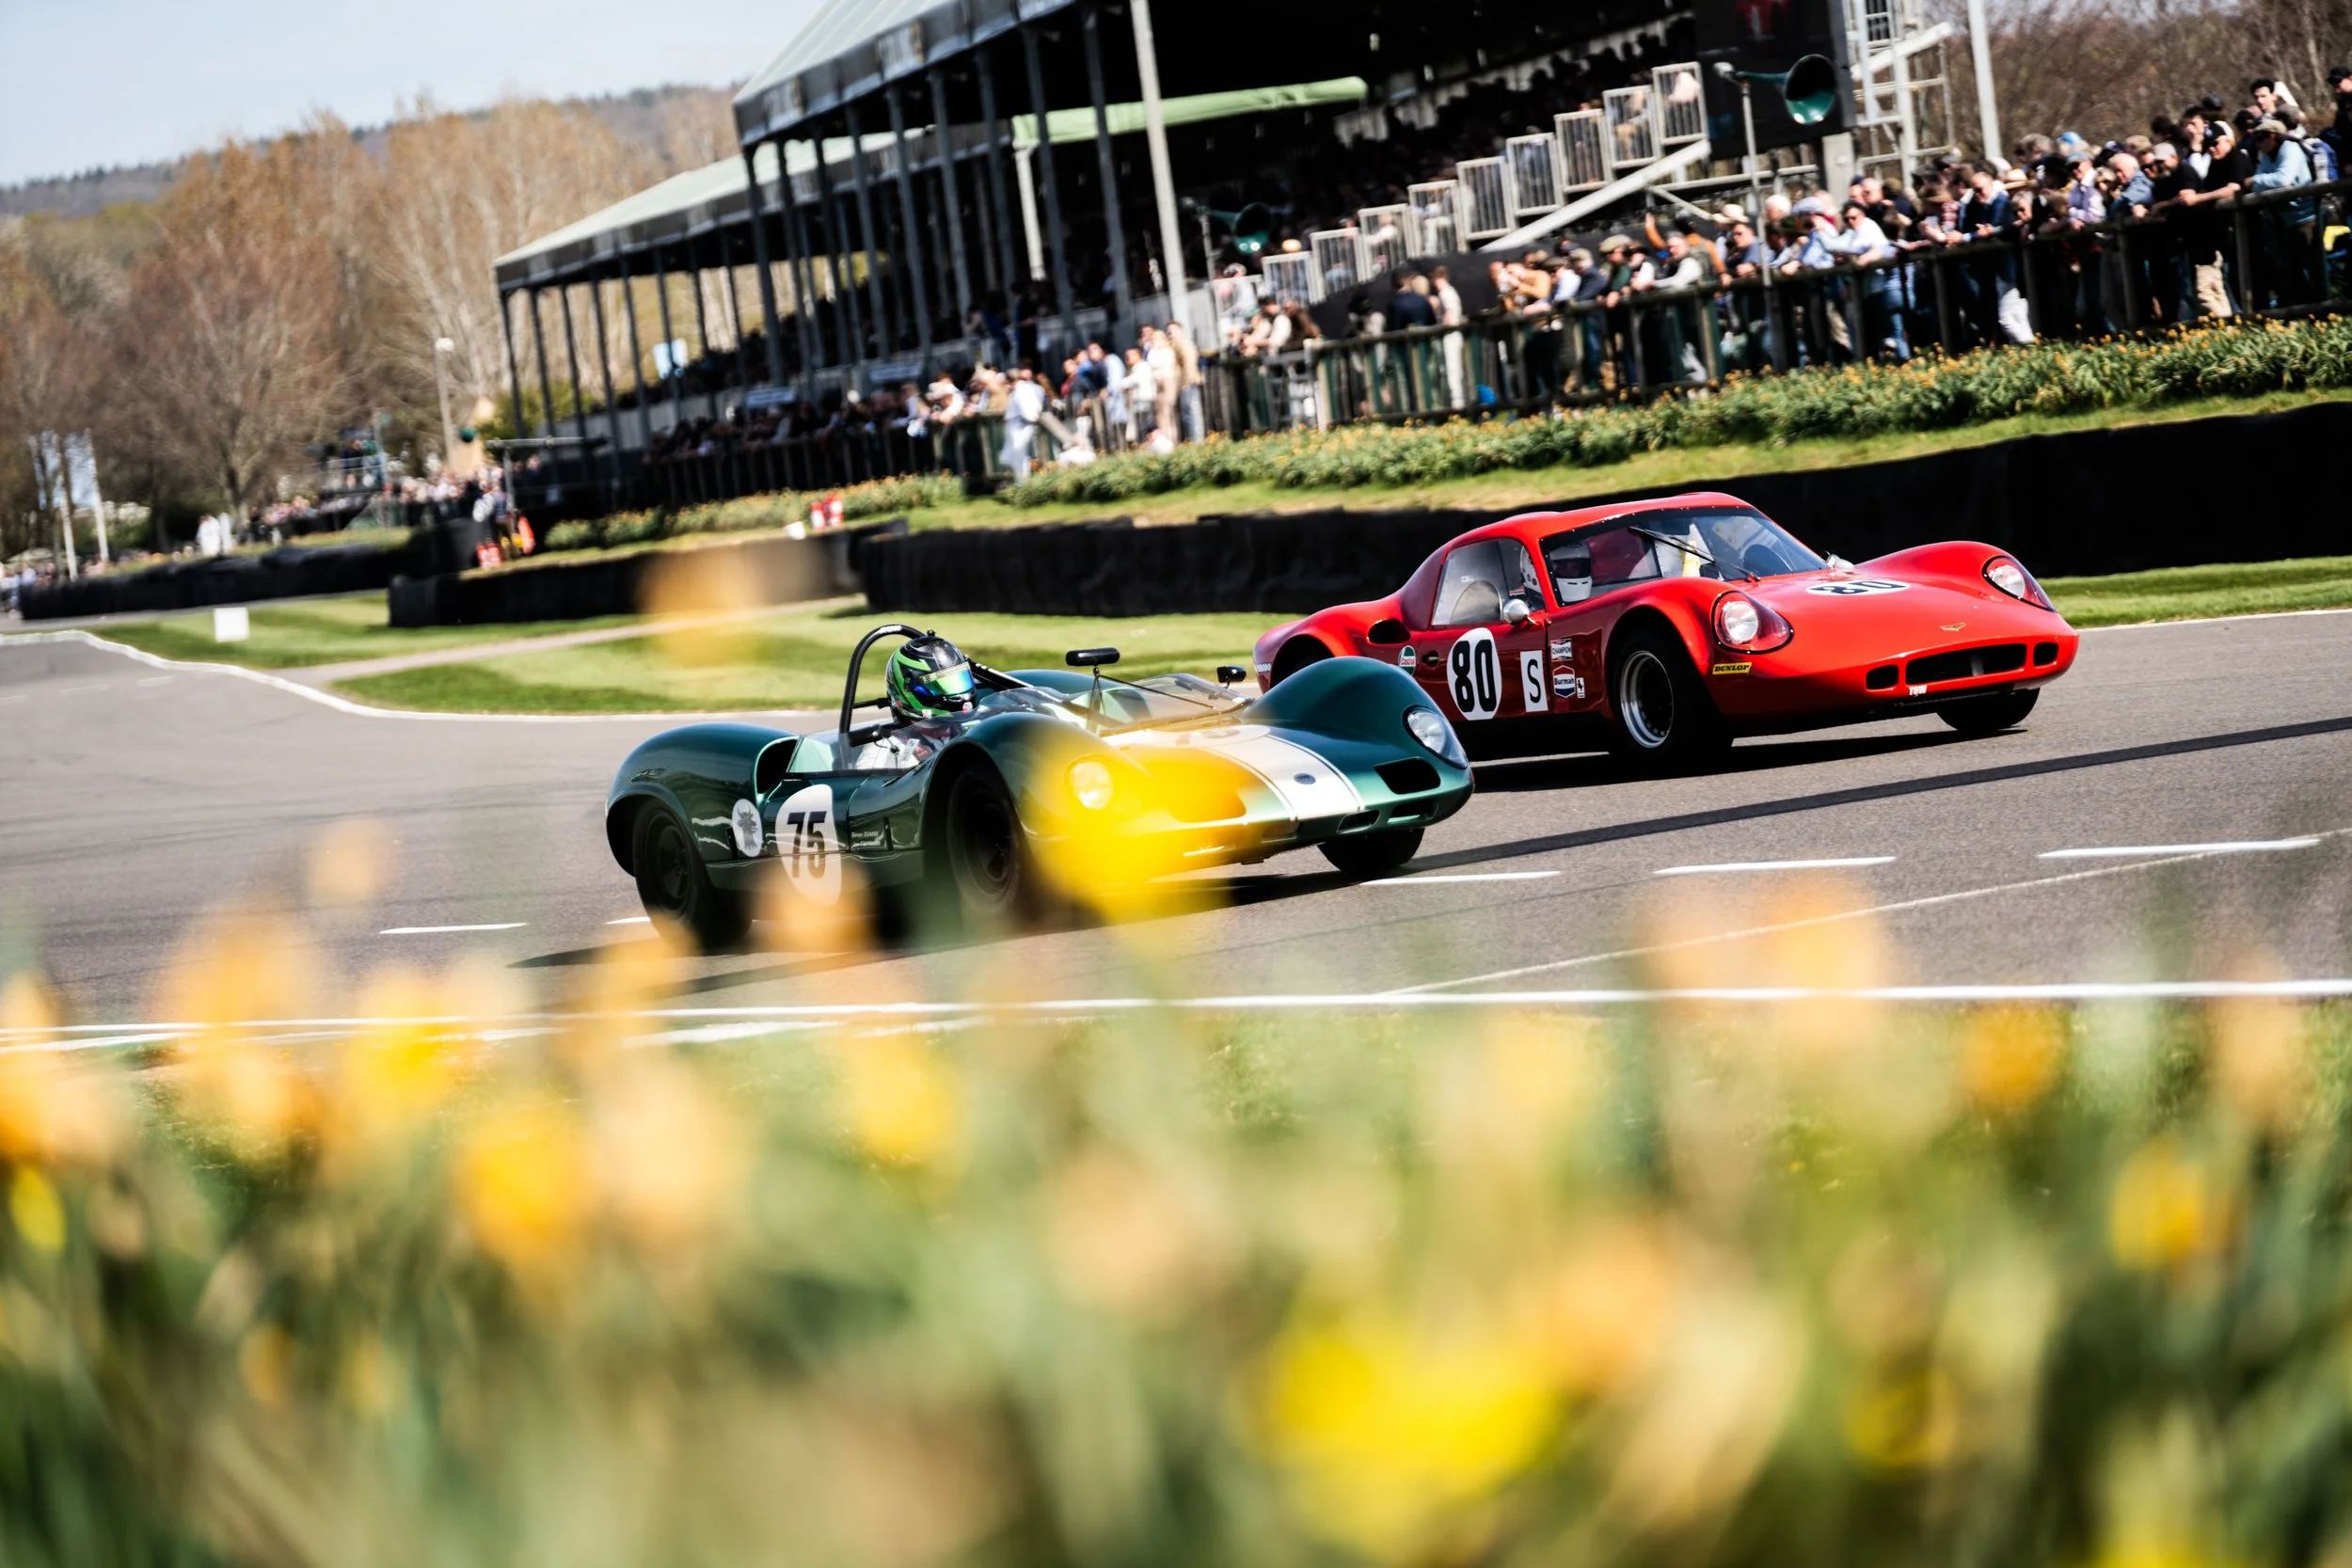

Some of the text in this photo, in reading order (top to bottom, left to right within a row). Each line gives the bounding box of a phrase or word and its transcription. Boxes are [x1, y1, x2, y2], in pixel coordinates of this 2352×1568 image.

[1809, 580, 1907, 594] 80
[1452, 639, 1498, 713] 80
[1527, 658, 1542, 704] S
[787, 811, 827, 879] 75
